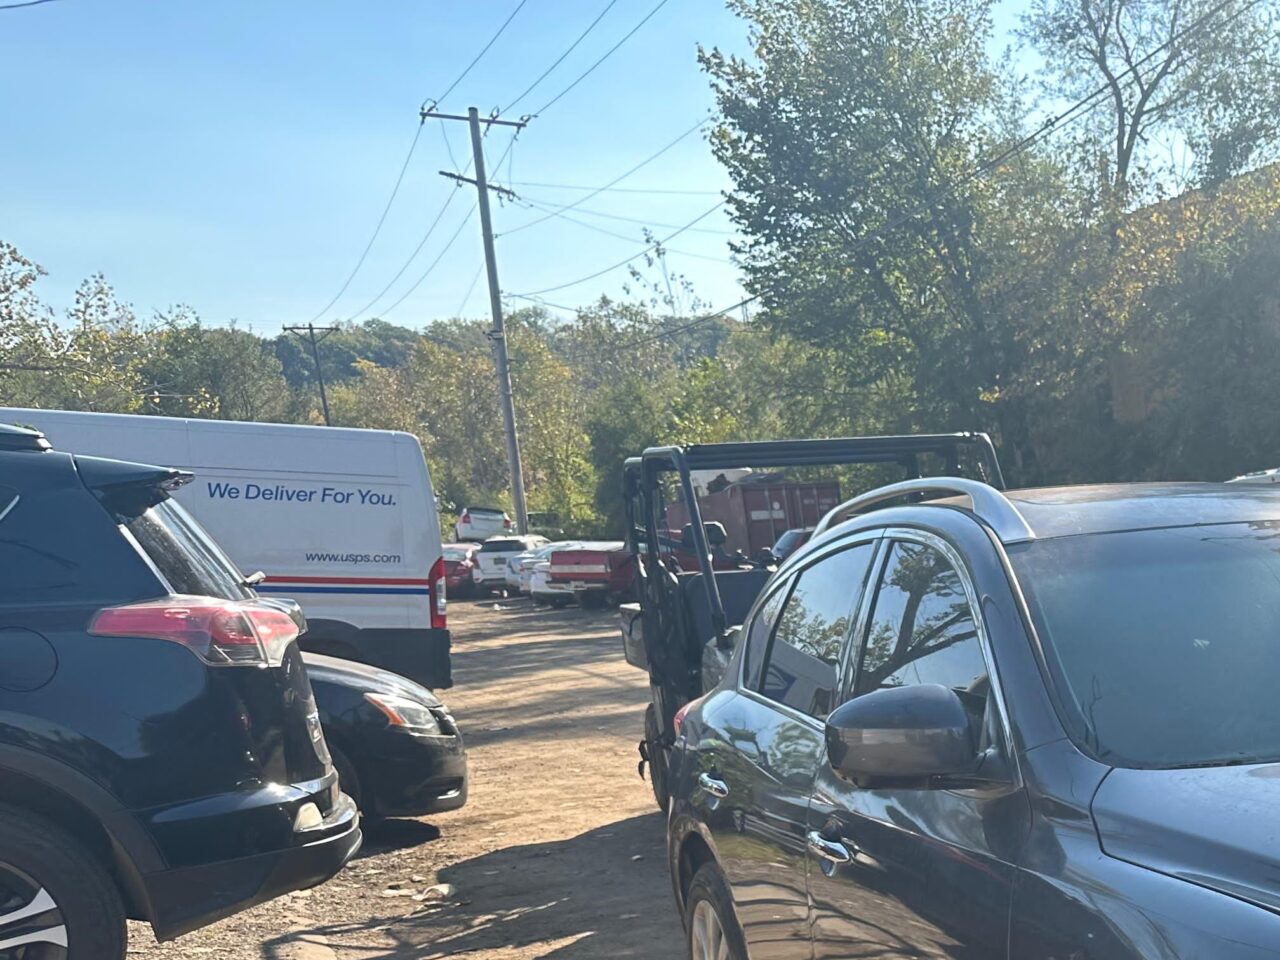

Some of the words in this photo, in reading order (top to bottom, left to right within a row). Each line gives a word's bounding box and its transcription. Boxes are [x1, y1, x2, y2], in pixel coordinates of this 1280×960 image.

[207, 482, 240, 499] We
[245, 484, 318, 502] Deliver
[321, 487, 355, 504] For
[357, 489, 397, 506] You.
[305, 553, 401, 565] www.usps.com
